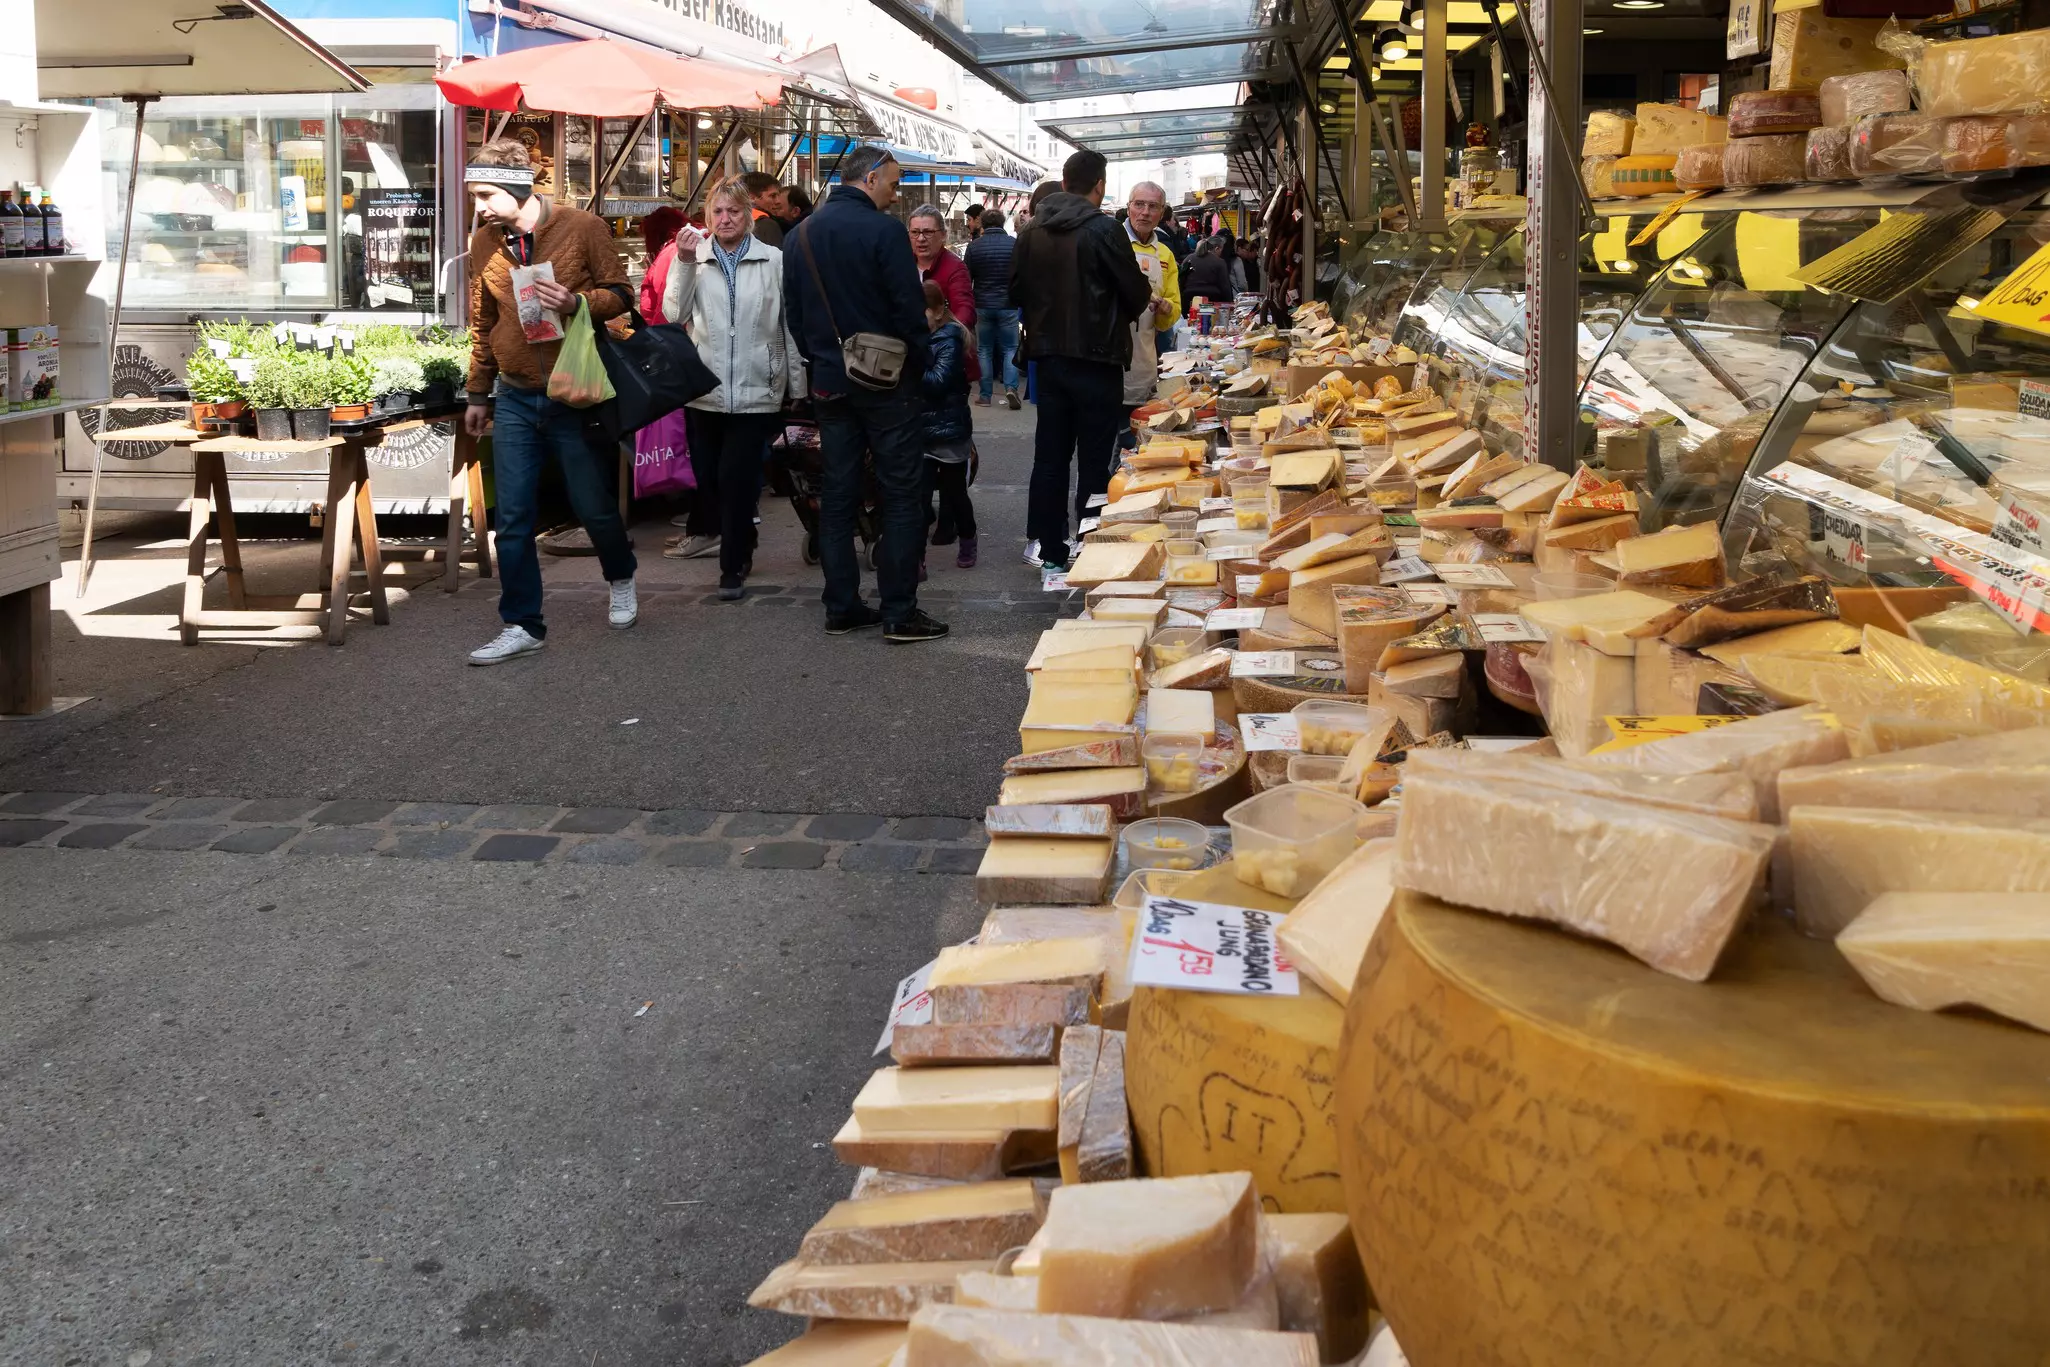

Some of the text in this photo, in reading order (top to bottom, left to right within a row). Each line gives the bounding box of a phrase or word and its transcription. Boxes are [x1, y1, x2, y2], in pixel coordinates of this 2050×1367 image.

[45, 365, 59, 373] SAFT
[1824, 514, 1863, 546] CHEDDAR
[2008, 501, 2040, 531] AKTION
[1215, 919, 1242, 957] JUNG
[1220, 1101, 1276, 1155] IT
